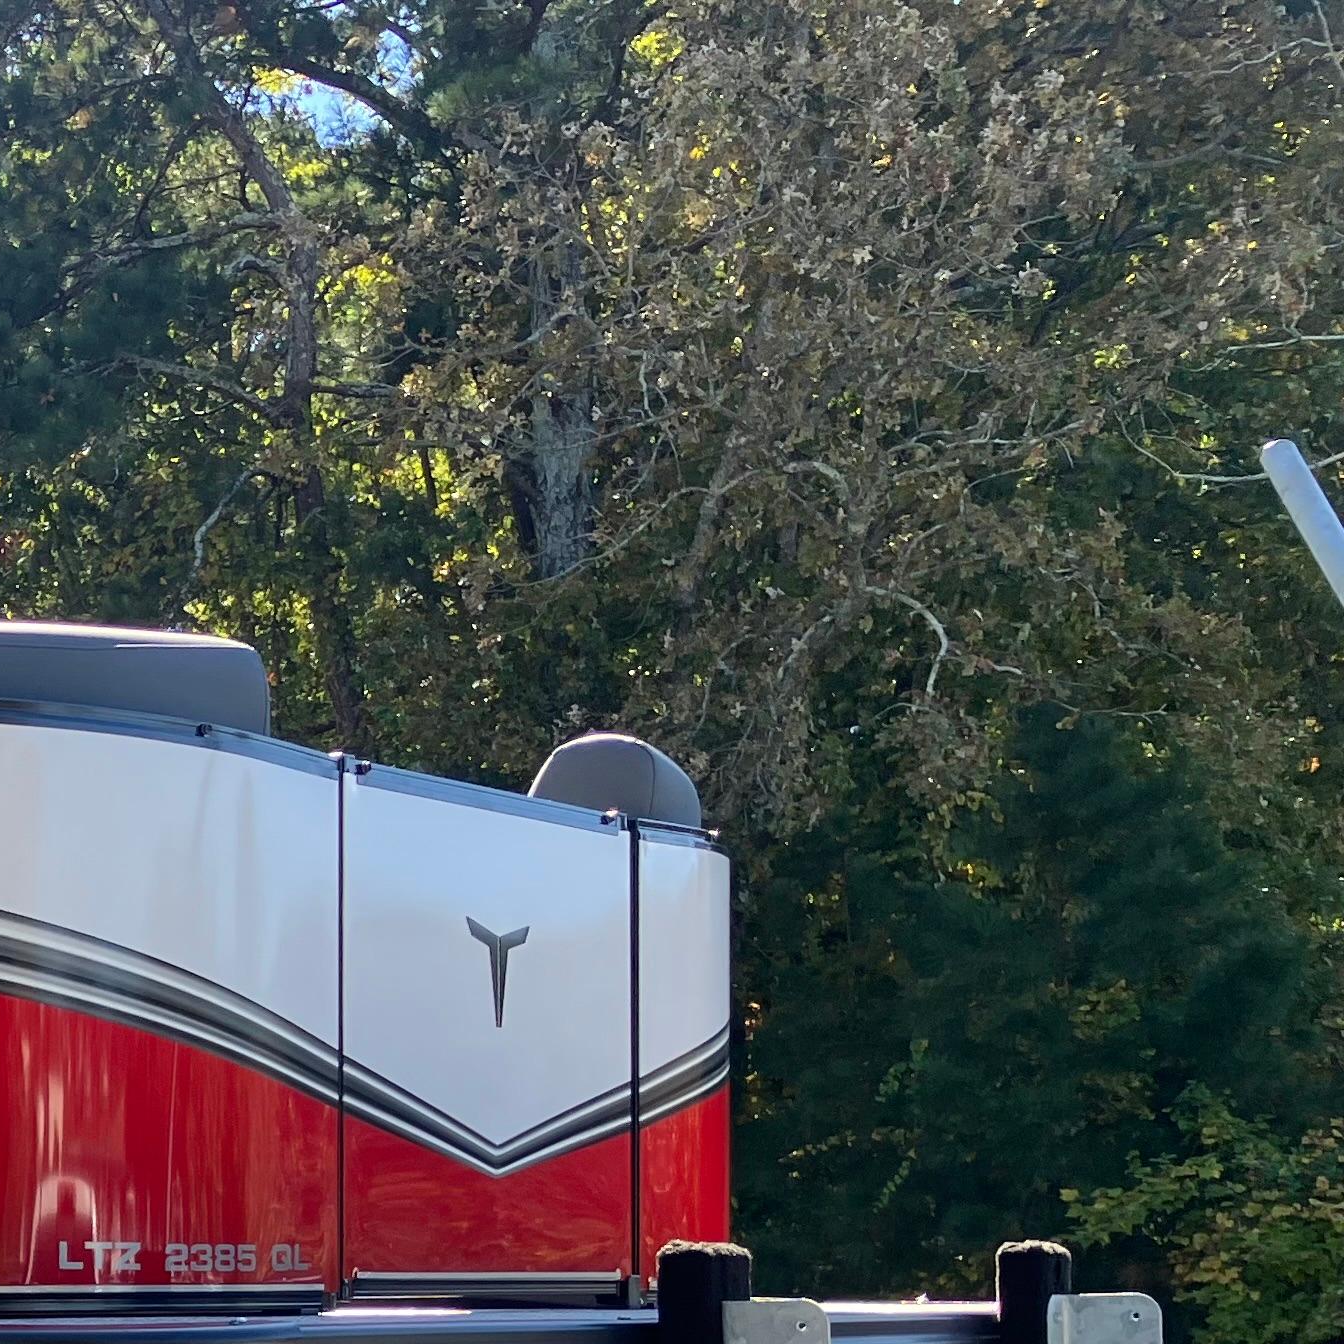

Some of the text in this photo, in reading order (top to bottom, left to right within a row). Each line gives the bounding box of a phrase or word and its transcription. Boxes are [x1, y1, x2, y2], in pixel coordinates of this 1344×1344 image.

[58, 1241, 310, 1272] LTZ 2385 QL
